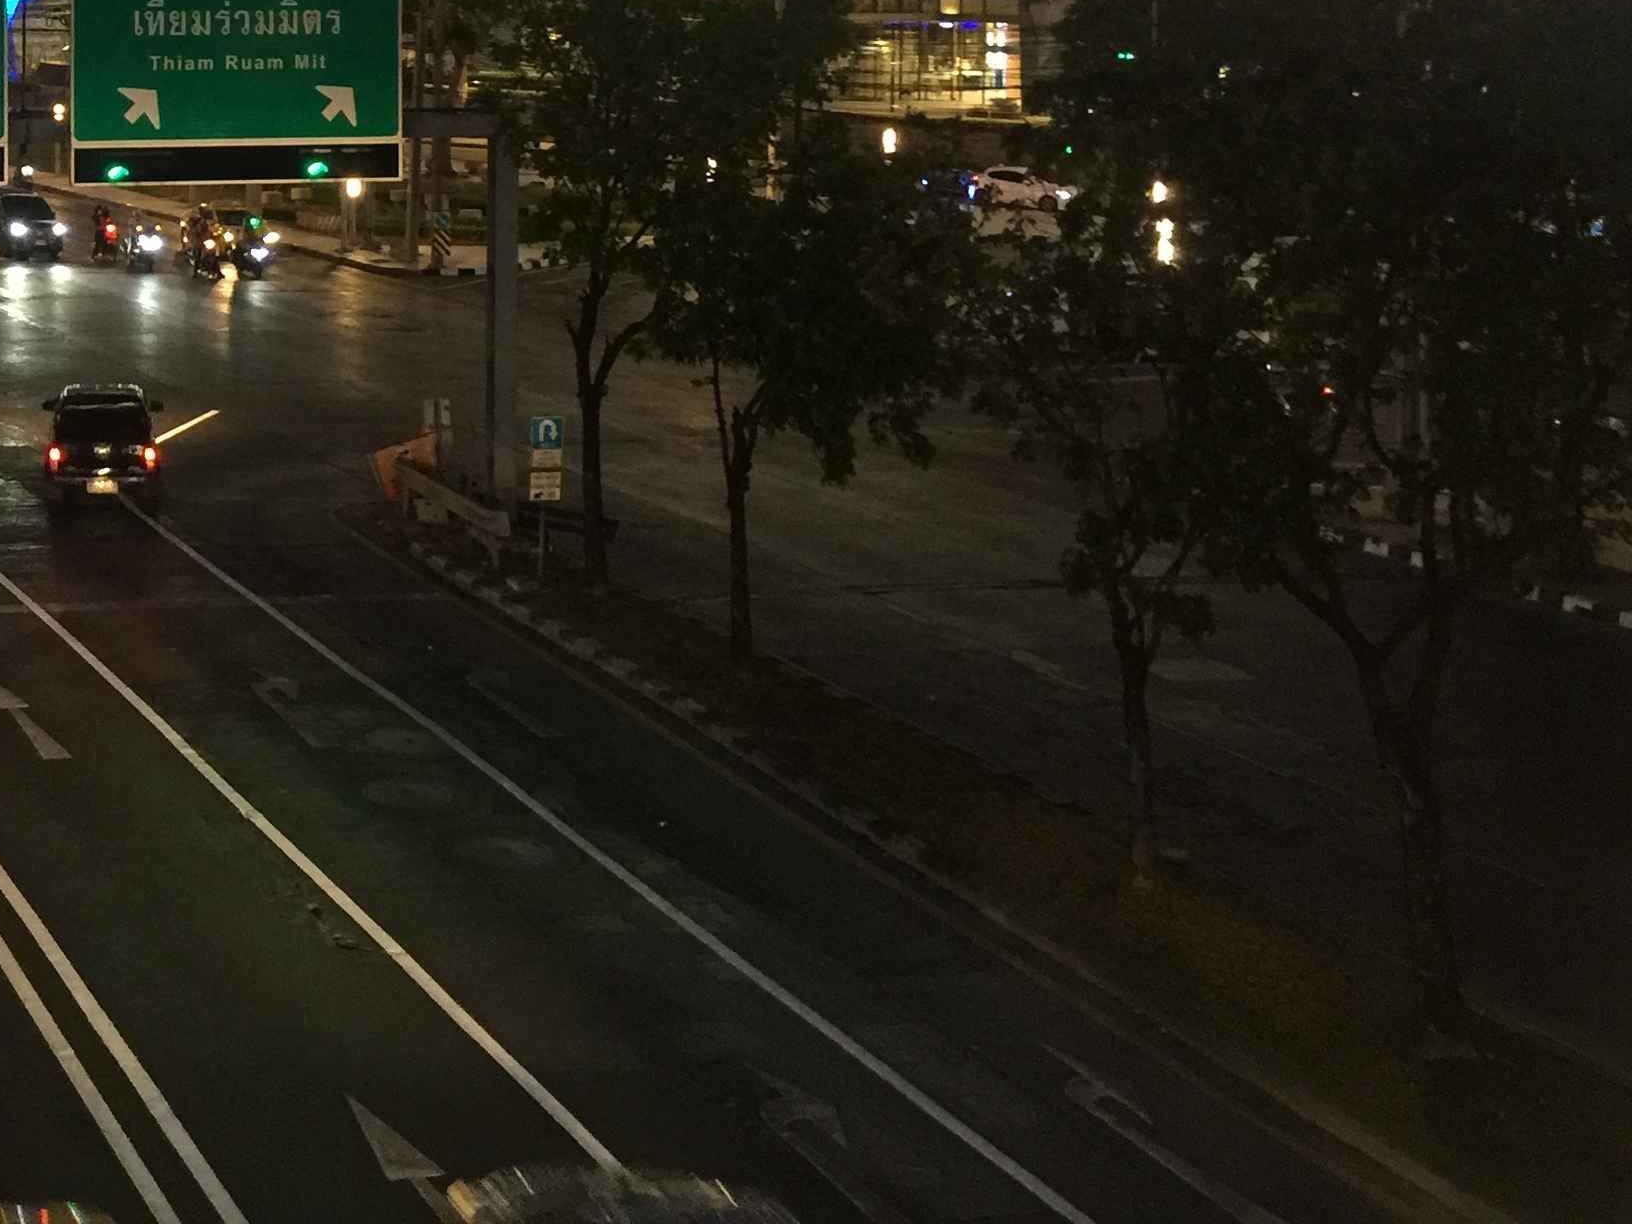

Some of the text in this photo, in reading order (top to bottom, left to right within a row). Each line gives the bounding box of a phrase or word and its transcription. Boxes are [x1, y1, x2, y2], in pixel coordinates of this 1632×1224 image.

[150, 54, 327, 71] Thiam Ruam Mit
